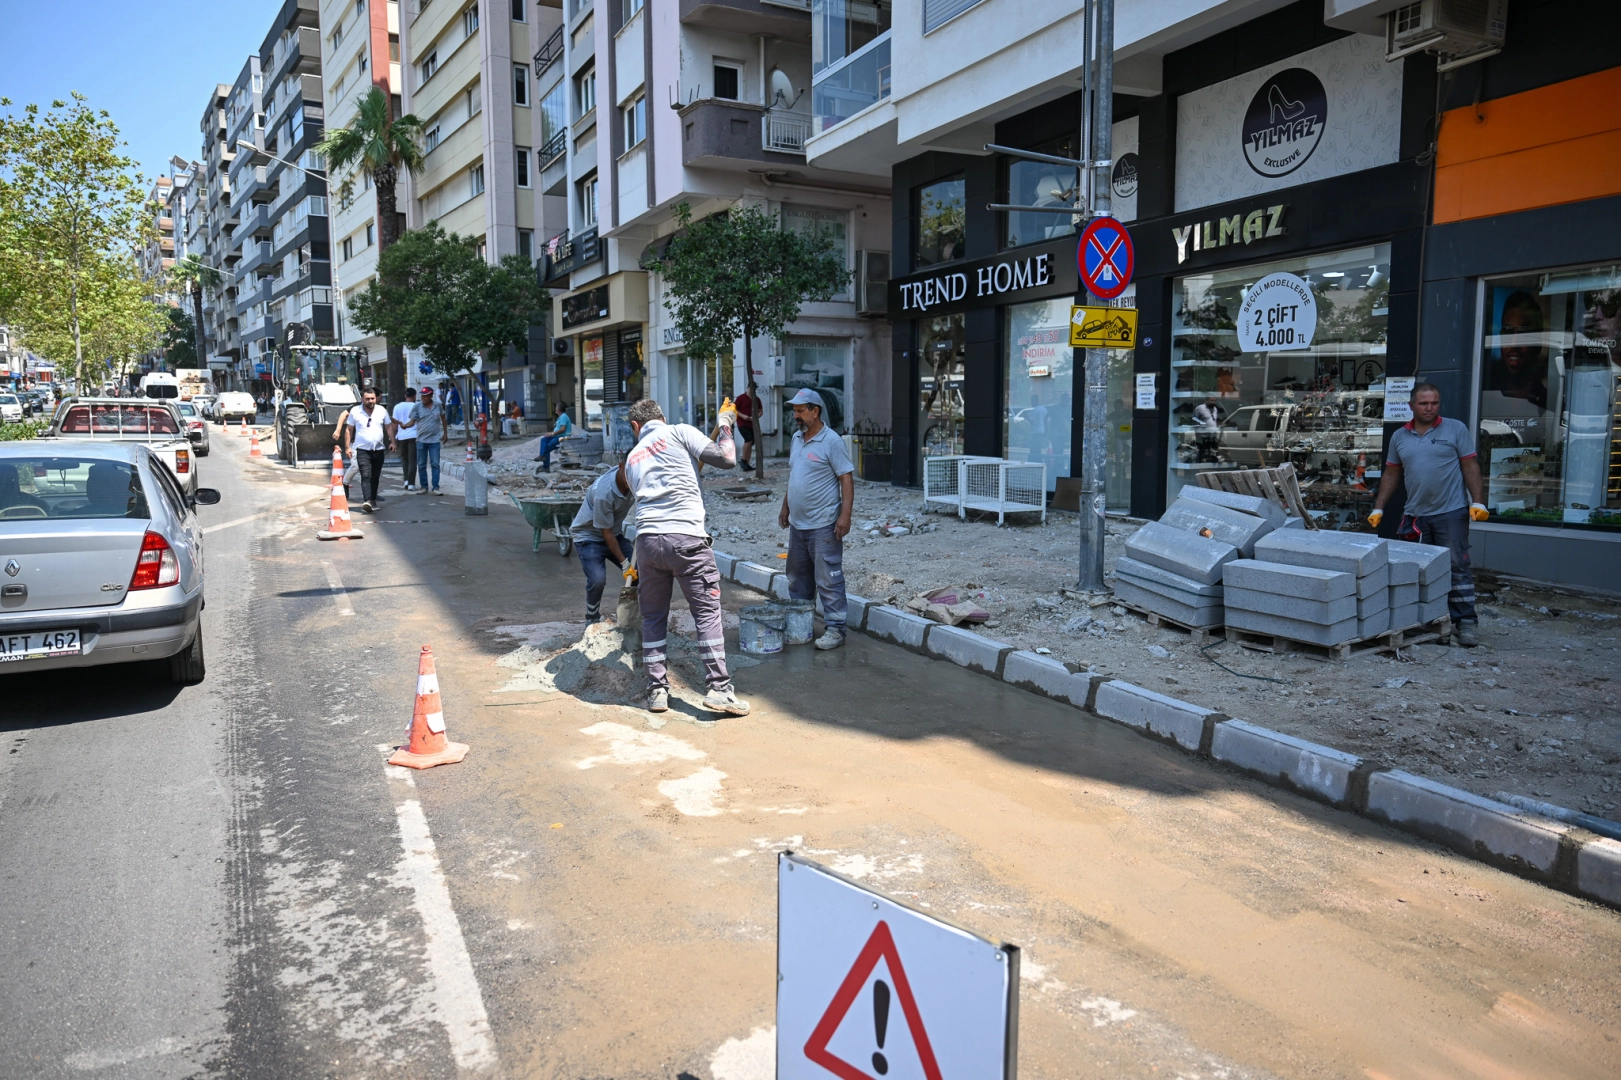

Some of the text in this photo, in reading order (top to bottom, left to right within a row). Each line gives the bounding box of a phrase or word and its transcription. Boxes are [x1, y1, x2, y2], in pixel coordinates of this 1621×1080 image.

[1250, 114, 1317, 153] YILMAZ
[1263, 148, 1302, 168] EXCLUSIVE
[787, 209, 838, 221] ENGLISH HOME
[1172, 204, 1285, 265] YILMAZ
[899, 253, 1049, 311] TREND HOME
[1243, 278, 1311, 313] SEÇİLİ MODELLERDE
[1254, 303, 1299, 329] 2 ÇİFT
[1043, 329, 1059, 343] %50
[1255, 327, 1306, 347] 4.000 TL
[1581, 338, 1617, 348] TOM FORD
[1022, 346, 1056, 360] İNDİRİM
[1496, 419, 1525, 427] LACOSTE
[42, 632, 77, 651] 462
